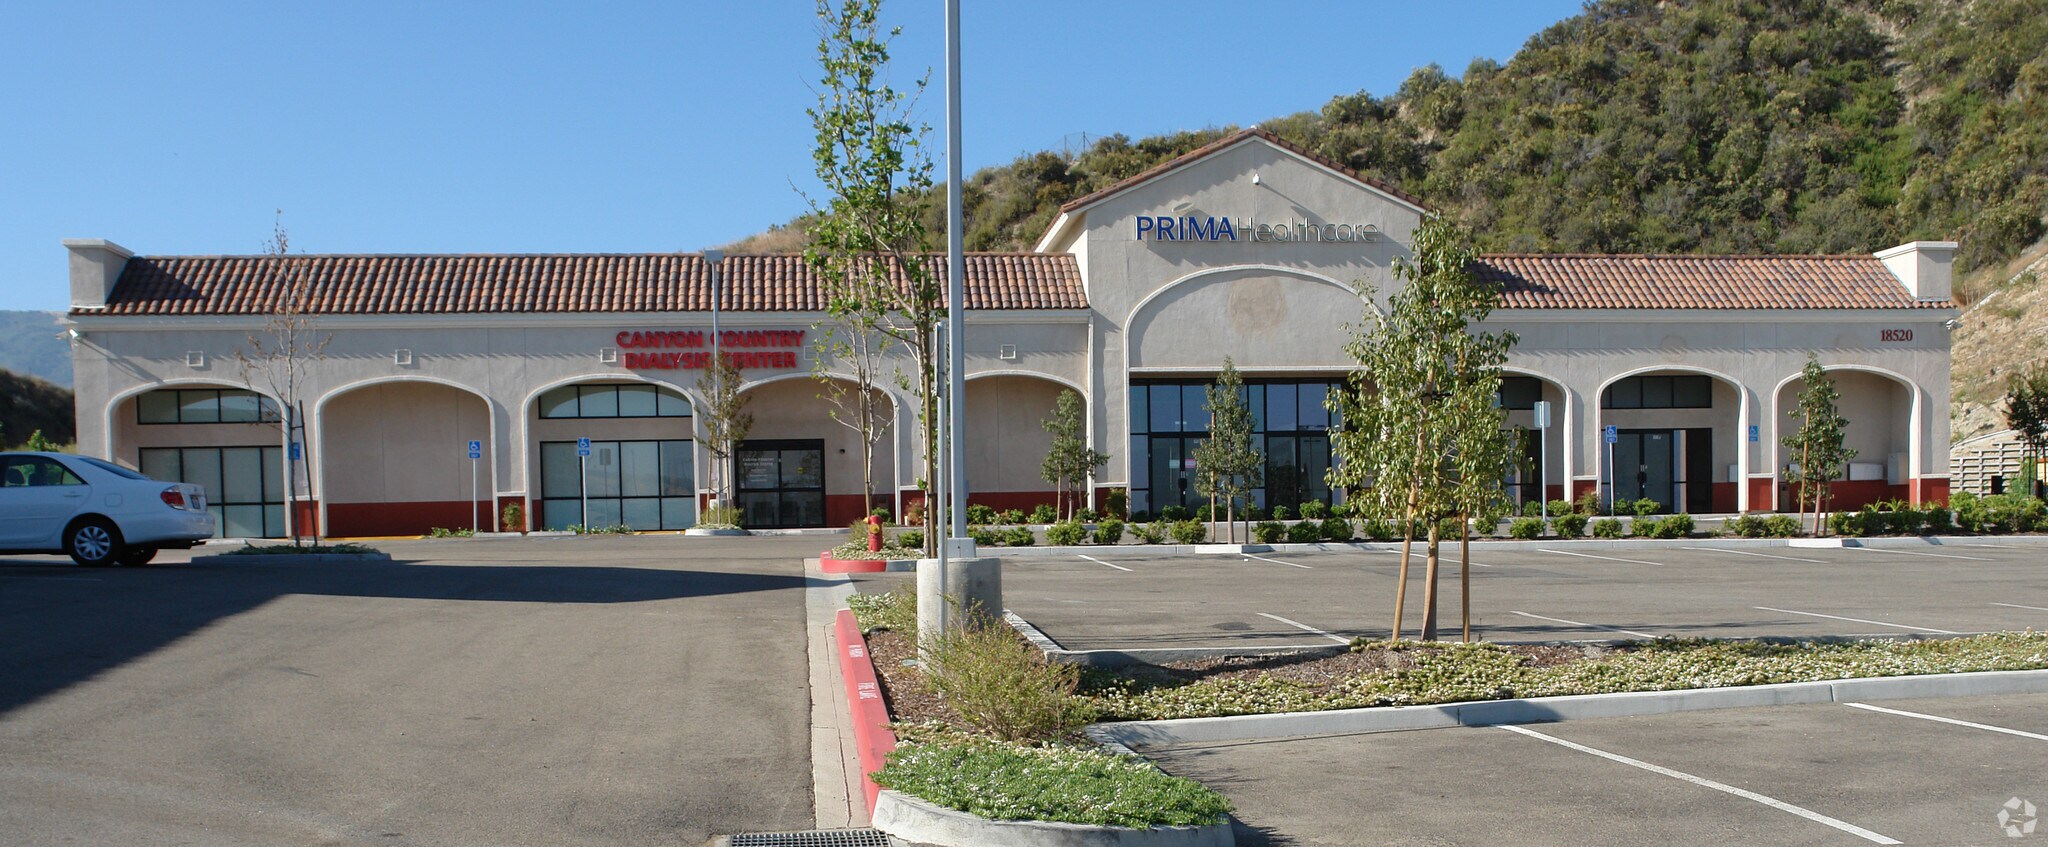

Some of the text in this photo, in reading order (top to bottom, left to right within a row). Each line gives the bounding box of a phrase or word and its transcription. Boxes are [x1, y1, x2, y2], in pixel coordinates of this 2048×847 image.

[616, 330, 805, 348] CANYON COUNTRY
[1881, 329, 1913, 341] 18520
[626, 352, 712, 369] DIALYSIS
